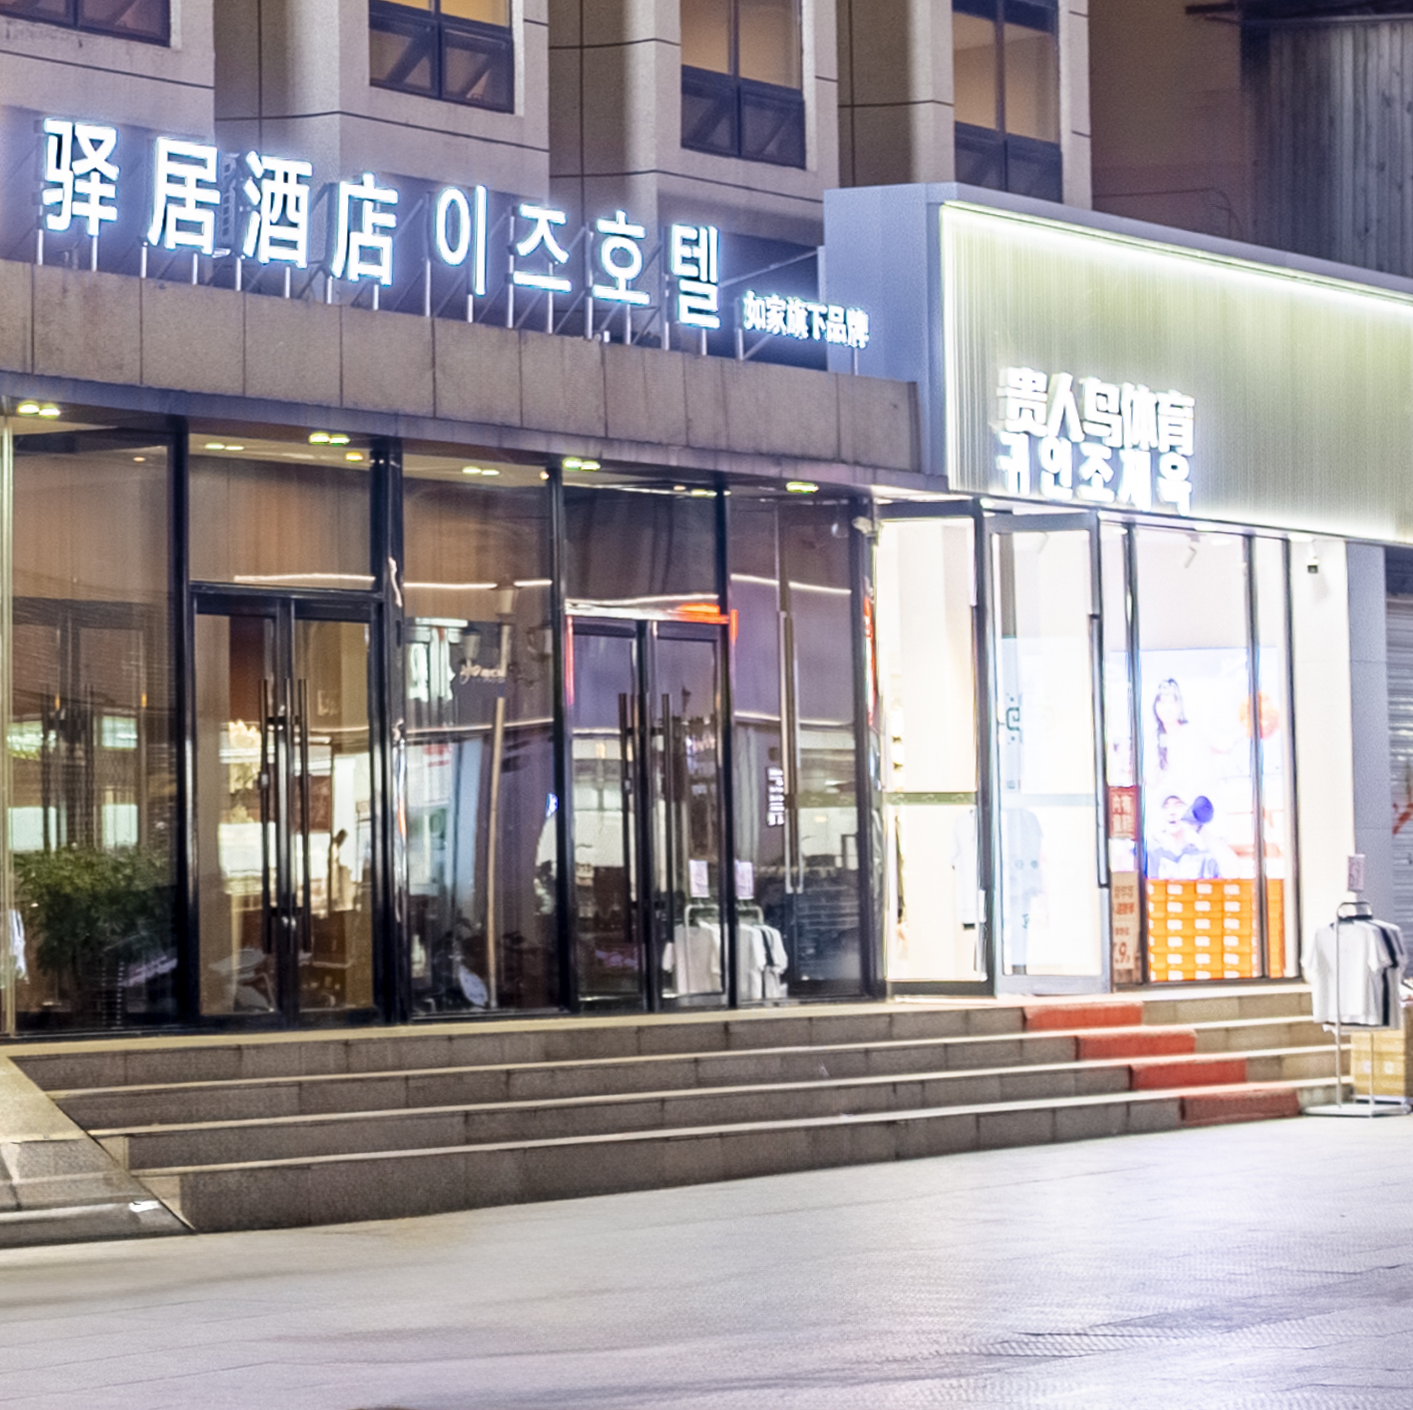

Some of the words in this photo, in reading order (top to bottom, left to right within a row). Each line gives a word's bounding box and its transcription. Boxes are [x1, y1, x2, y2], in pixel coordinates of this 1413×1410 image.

[41, 117, 399, 286] 驿居酒店
[434, 184, 722, 329] 이즈호텔
[742, 289, 870, 349] 如家旗下品牌
[998, 367, 1196, 457] 贵人鸟体育
